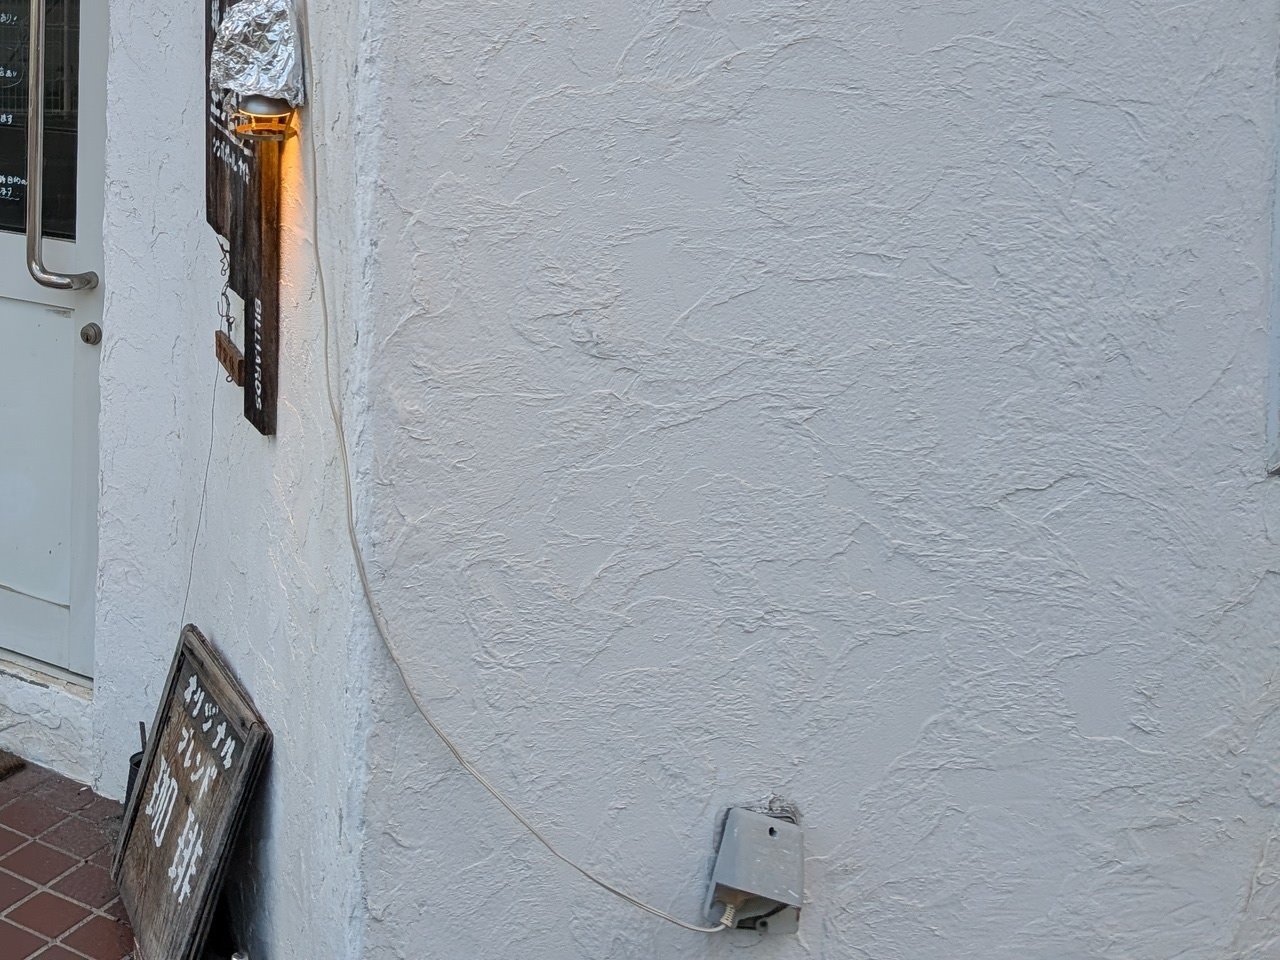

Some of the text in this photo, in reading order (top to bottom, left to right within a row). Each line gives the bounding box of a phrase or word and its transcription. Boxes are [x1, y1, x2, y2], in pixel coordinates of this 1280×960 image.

[253, 297, 263, 412] BILLIARDS
[177, 726, 219, 800] ブレンド
[183, 673, 236, 770] オリジナル
